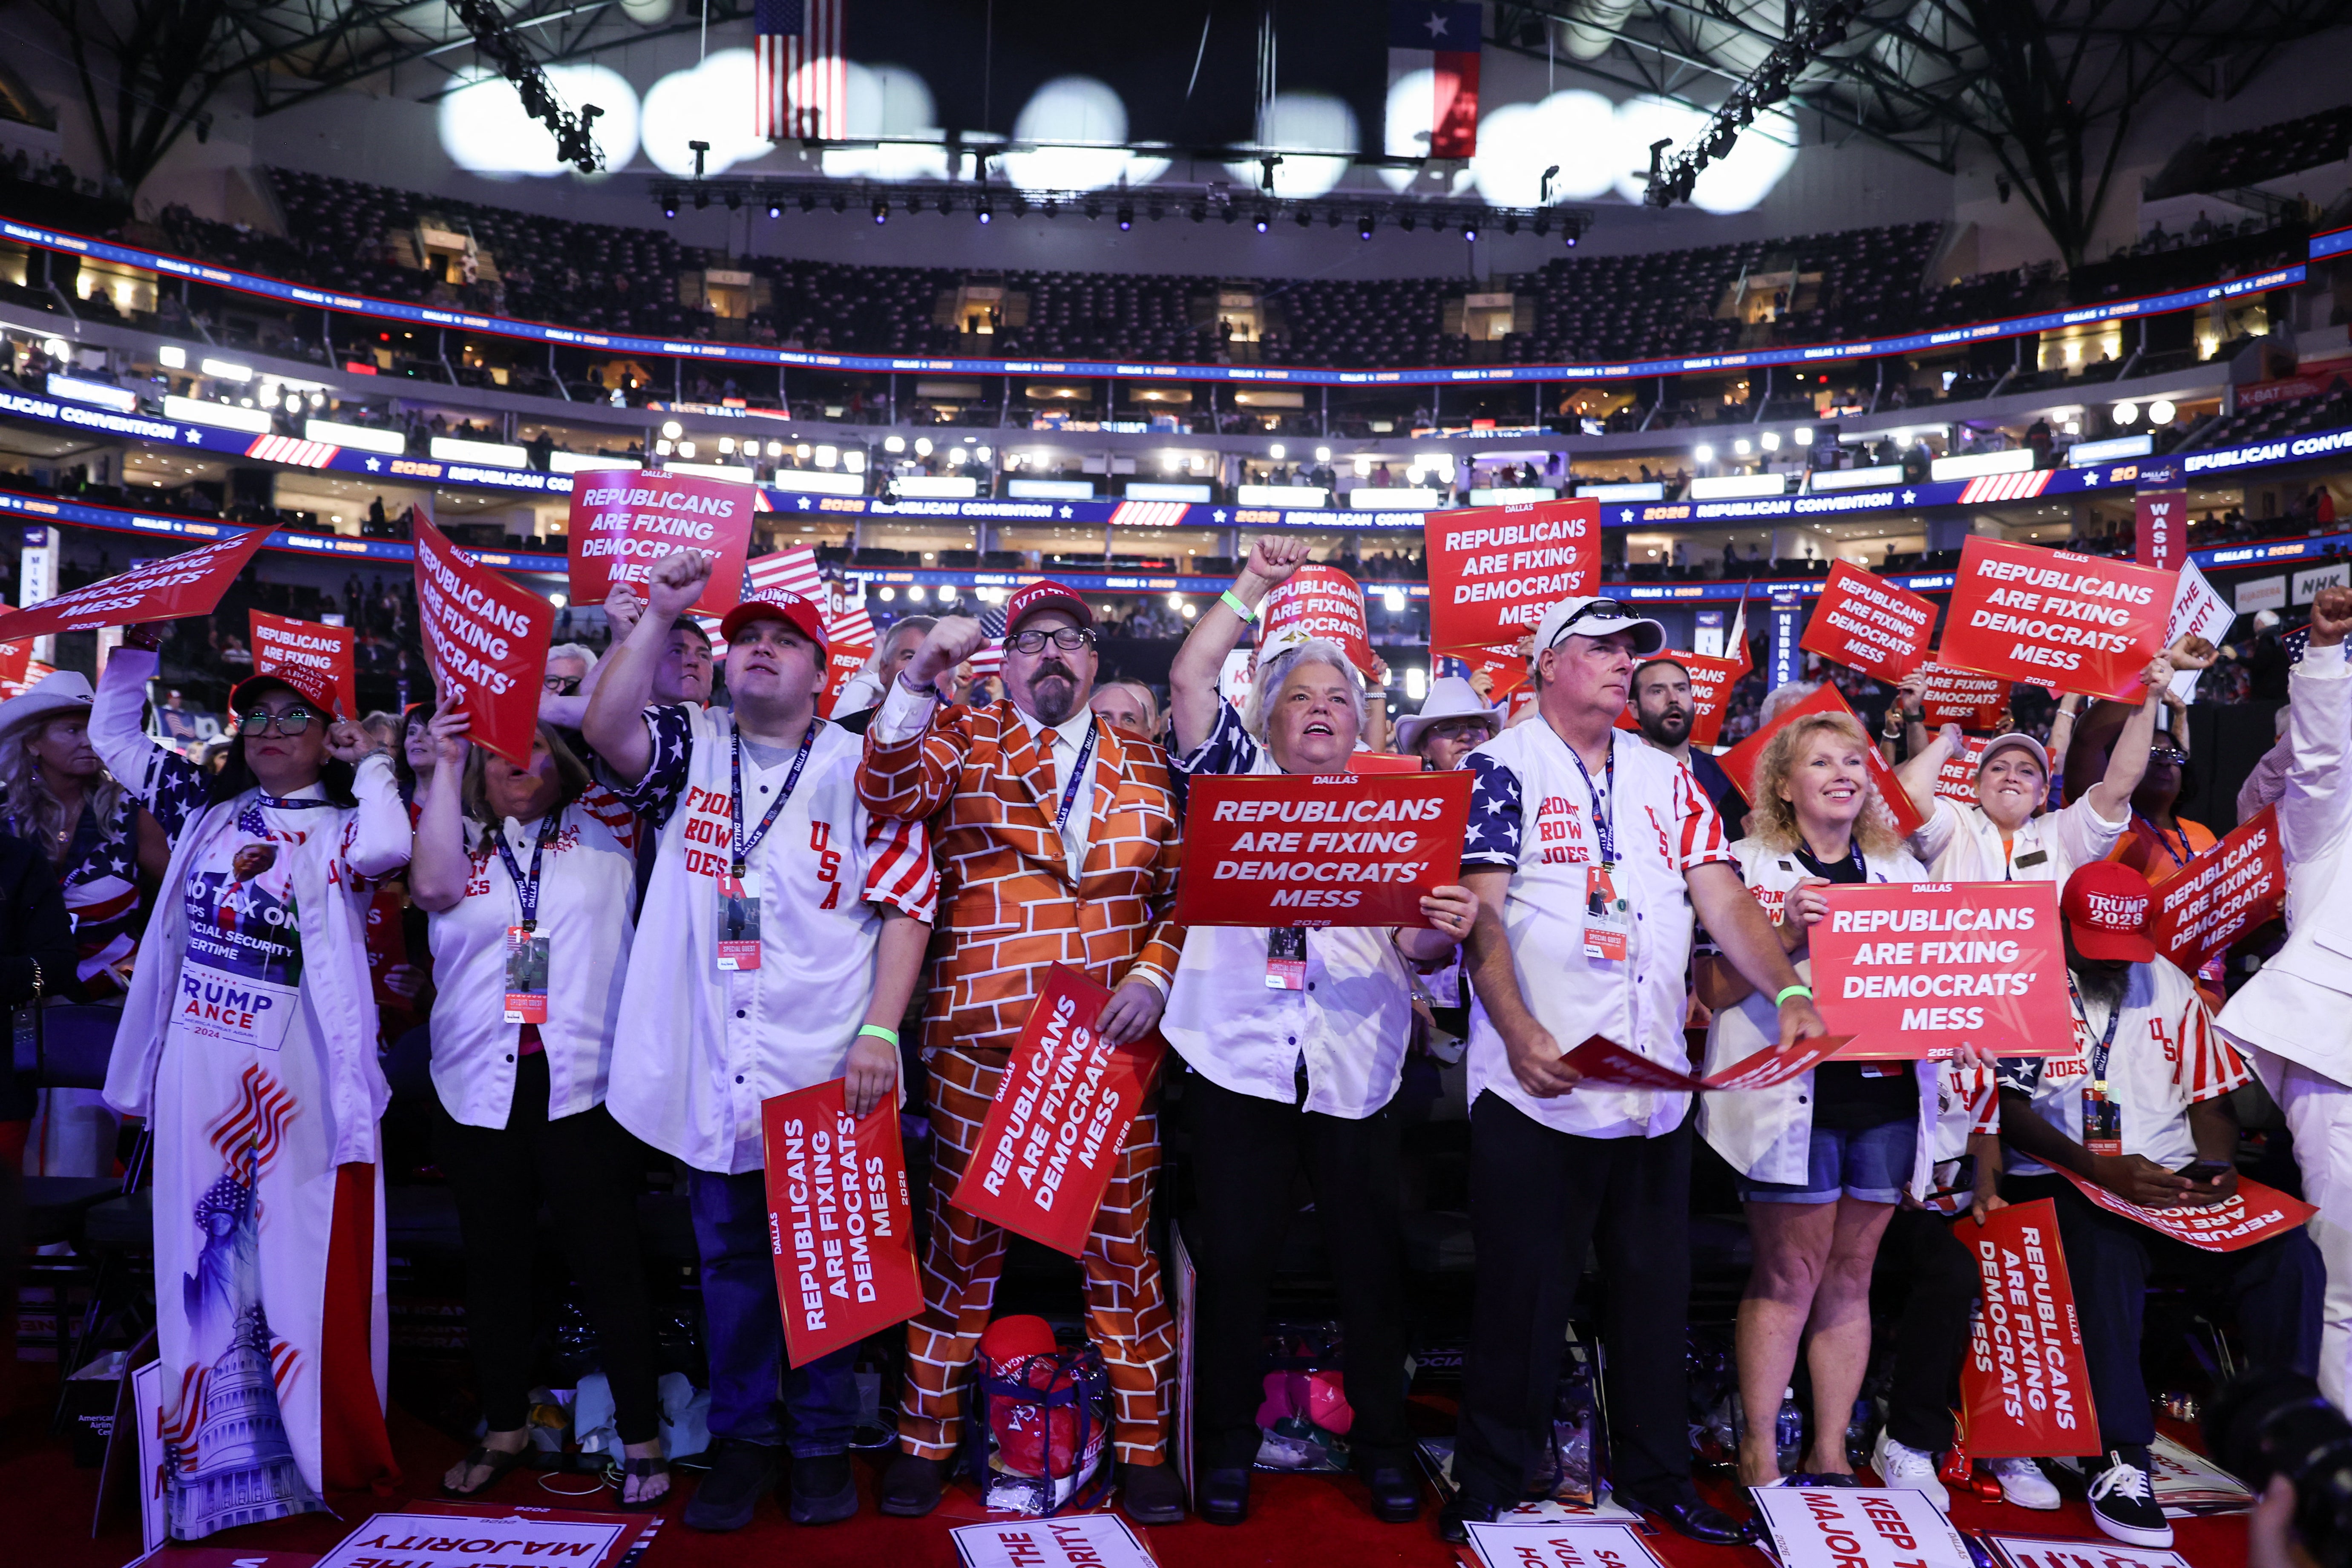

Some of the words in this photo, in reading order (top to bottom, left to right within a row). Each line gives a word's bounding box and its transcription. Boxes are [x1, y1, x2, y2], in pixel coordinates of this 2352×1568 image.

[60, 406, 177, 440] CONVENTION
[2185, 443, 2287, 472] EPUBLICAN
[391, 460, 442, 477] 2026
[448, 466, 543, 489] REPUBLICAN
[641, 469, 673, 479] DALLAS
[2142, 471, 2171, 479] DALLAS
[583, 488, 735, 518] REPUBLICANS
[819, 498, 866, 512] 2026
[961, 503, 1053, 518] CONVENTION
[1505, 503, 1534, 513] DALLAS
[1643, 506, 1690, 521] 2026
[1696, 500, 1791, 518] REPUBLICAN
[1794, 492, 1894, 513] CONVENTION
[589, 513, 630, 532] ARE
[633, 517, 714, 540] FIXING
[1235, 511, 1280, 523] 2026
[1285, 512, 1373, 526] REPUBLICAN
[1445, 518, 1586, 551] REPUBLICANS
[449, 545, 475, 567] DALLAS
[1462, 555, 1507, 577] ARE
[1513, 547, 1577, 571] FIXING
[2053, 551, 2089, 563] DALLAS
[2214, 549, 2253, 562] DALLAS
[419, 538, 531, 637] REPUBLICANS
[1454, 571, 1585, 604] DEMOCRATS'
[1881, 579, 1900, 591] DALLAS
[1909, 577, 1943, 588] DALLAS
[1977, 560, 2154, 605] REPUBLICANS
[2302, 575, 2340, 595] NHK
[57, 595, 145, 618] MESS
[1270, 601, 1303, 624] ARE
[1307, 598, 1358, 620] FIXING
[1837, 576, 1927, 626] REPUBLICANS
[1986, 588, 2038, 611] ARE
[2041, 596, 2130, 627] FIXING
[2177, 581, 2199, 617] THE
[66, 621, 106, 630] 2026
[422, 579, 442, 617] ARE
[442, 607, 509, 661] FIXING
[1839, 598, 1871, 618] ARE
[1870, 610, 1915, 639] FIXING
[256, 625, 341, 653] REPUBLICANS
[1826, 612, 1916, 656] DEMOCRATS'
[1970, 610, 2137, 653] DEMOCRATS'
[263, 645, 282, 661] ARE
[285, 651, 331, 670] FIXING
[422, 601, 516, 695] DEMOCRATS'
[1671, 650, 1692, 658] DALLAS
[1843, 639, 1886, 664] MESS
[2009, 644, 2082, 671] MESS
[282, 668, 325, 689] ABOUT
[1848, 662, 1867, 673] 2026
[1926, 676, 1952, 688] ARE
[1954, 679, 1998, 690] FIXING
[2024, 676, 2056, 687] 2026
[1936, 706, 1974, 716] MESS
[1085, 728, 1095, 750] DALLAS
[794, 749, 807, 771] DALLAS
[1313, 776, 1359, 784] DALLAS
[1213, 798, 1444, 822] REPUBLICANS
[685, 819, 733, 849] ROW
[740, 831, 763, 856] DALLAS
[1231, 832, 1303, 852] ARE
[1307, 831, 1417, 853] FIXING
[1539, 821, 1582, 841] ROW
[1542, 847, 1589, 865] JOES
[2203, 840, 2224, 858] DALLAS
[723, 876, 731, 889] 1
[1213, 861, 1429, 883] DEMOCRATS'
[1592, 869, 1600, 882] 1
[2163, 829, 2267, 913] REPUBLICANS
[528, 881, 538, 908] DALLAS
[1270, 890, 1362, 907] MESS
[1912, 883, 1952, 893] DALLAS
[2176, 897, 2208, 927] ARE
[2213, 857, 2262, 903] FIXING
[187, 903, 205, 918] TIPS
[212, 886, 256, 918] TAX
[2087, 894, 2149, 913] TRUMP
[2171, 872, 2272, 951] DEMOCRATS'
[1832, 908, 2035, 933] REPUBLICANS
[2090, 910, 2143, 925] 2028
[225, 930, 294, 957] SECURITY
[512, 929, 521, 942] 1
[1589, 934, 1606, 943] SPECIAL
[1607, 936, 1621, 944] GUEST
[2202, 913, 2245, 950] MESS
[1852, 942, 1914, 965] ARE
[1920, 940, 2018, 964] FIXING
[1842, 973, 2037, 998] DEMOCRATS'
[1900, 1007, 1984, 1030] MESS
[194, 1027, 220, 1039] 2024
[2045, 1059, 2088, 1078] JOES
[996, 1062, 1016, 1103] DALLAS
[982, 995, 1076, 1197] REPUBLICANS
[1016, 1124, 1051, 1190] ARE
[1040, 1026, 1090, 1125] FIXING
[1078, 1087, 1120, 1170] MESS
[1112, 1120, 1130, 1155] 2026
[812, 1131, 839, 1231] FIXING
[898, 1171, 908, 1205] 2026
[837, 1111, 876, 1303] DEMOCRATS'
[866, 1157, 892, 1236] MESS
[784, 1119, 826, 1331] REPUBLICANS
[2194, 1207, 2245, 1229] ARE
[770, 1212, 781, 1254] DALLAS
[823, 1239, 849, 1299] ARE
[1980, 1241, 2024, 1427] DEMOCRATS'
[2002, 1249, 2028, 1306] ARE
[2015, 1314, 2046, 1411] FIXING
[2021, 1227, 2075, 1430] REPUBLICANS
[2065, 1304, 2080, 1345] DALLAS
[1857, 1497, 1917, 1550] KEEP
[355, 1534, 597, 1556] MAJORITY
[1775, 1535, 1791, 1556] 2026
[1948, 1532, 1967, 1559] DALLAS
